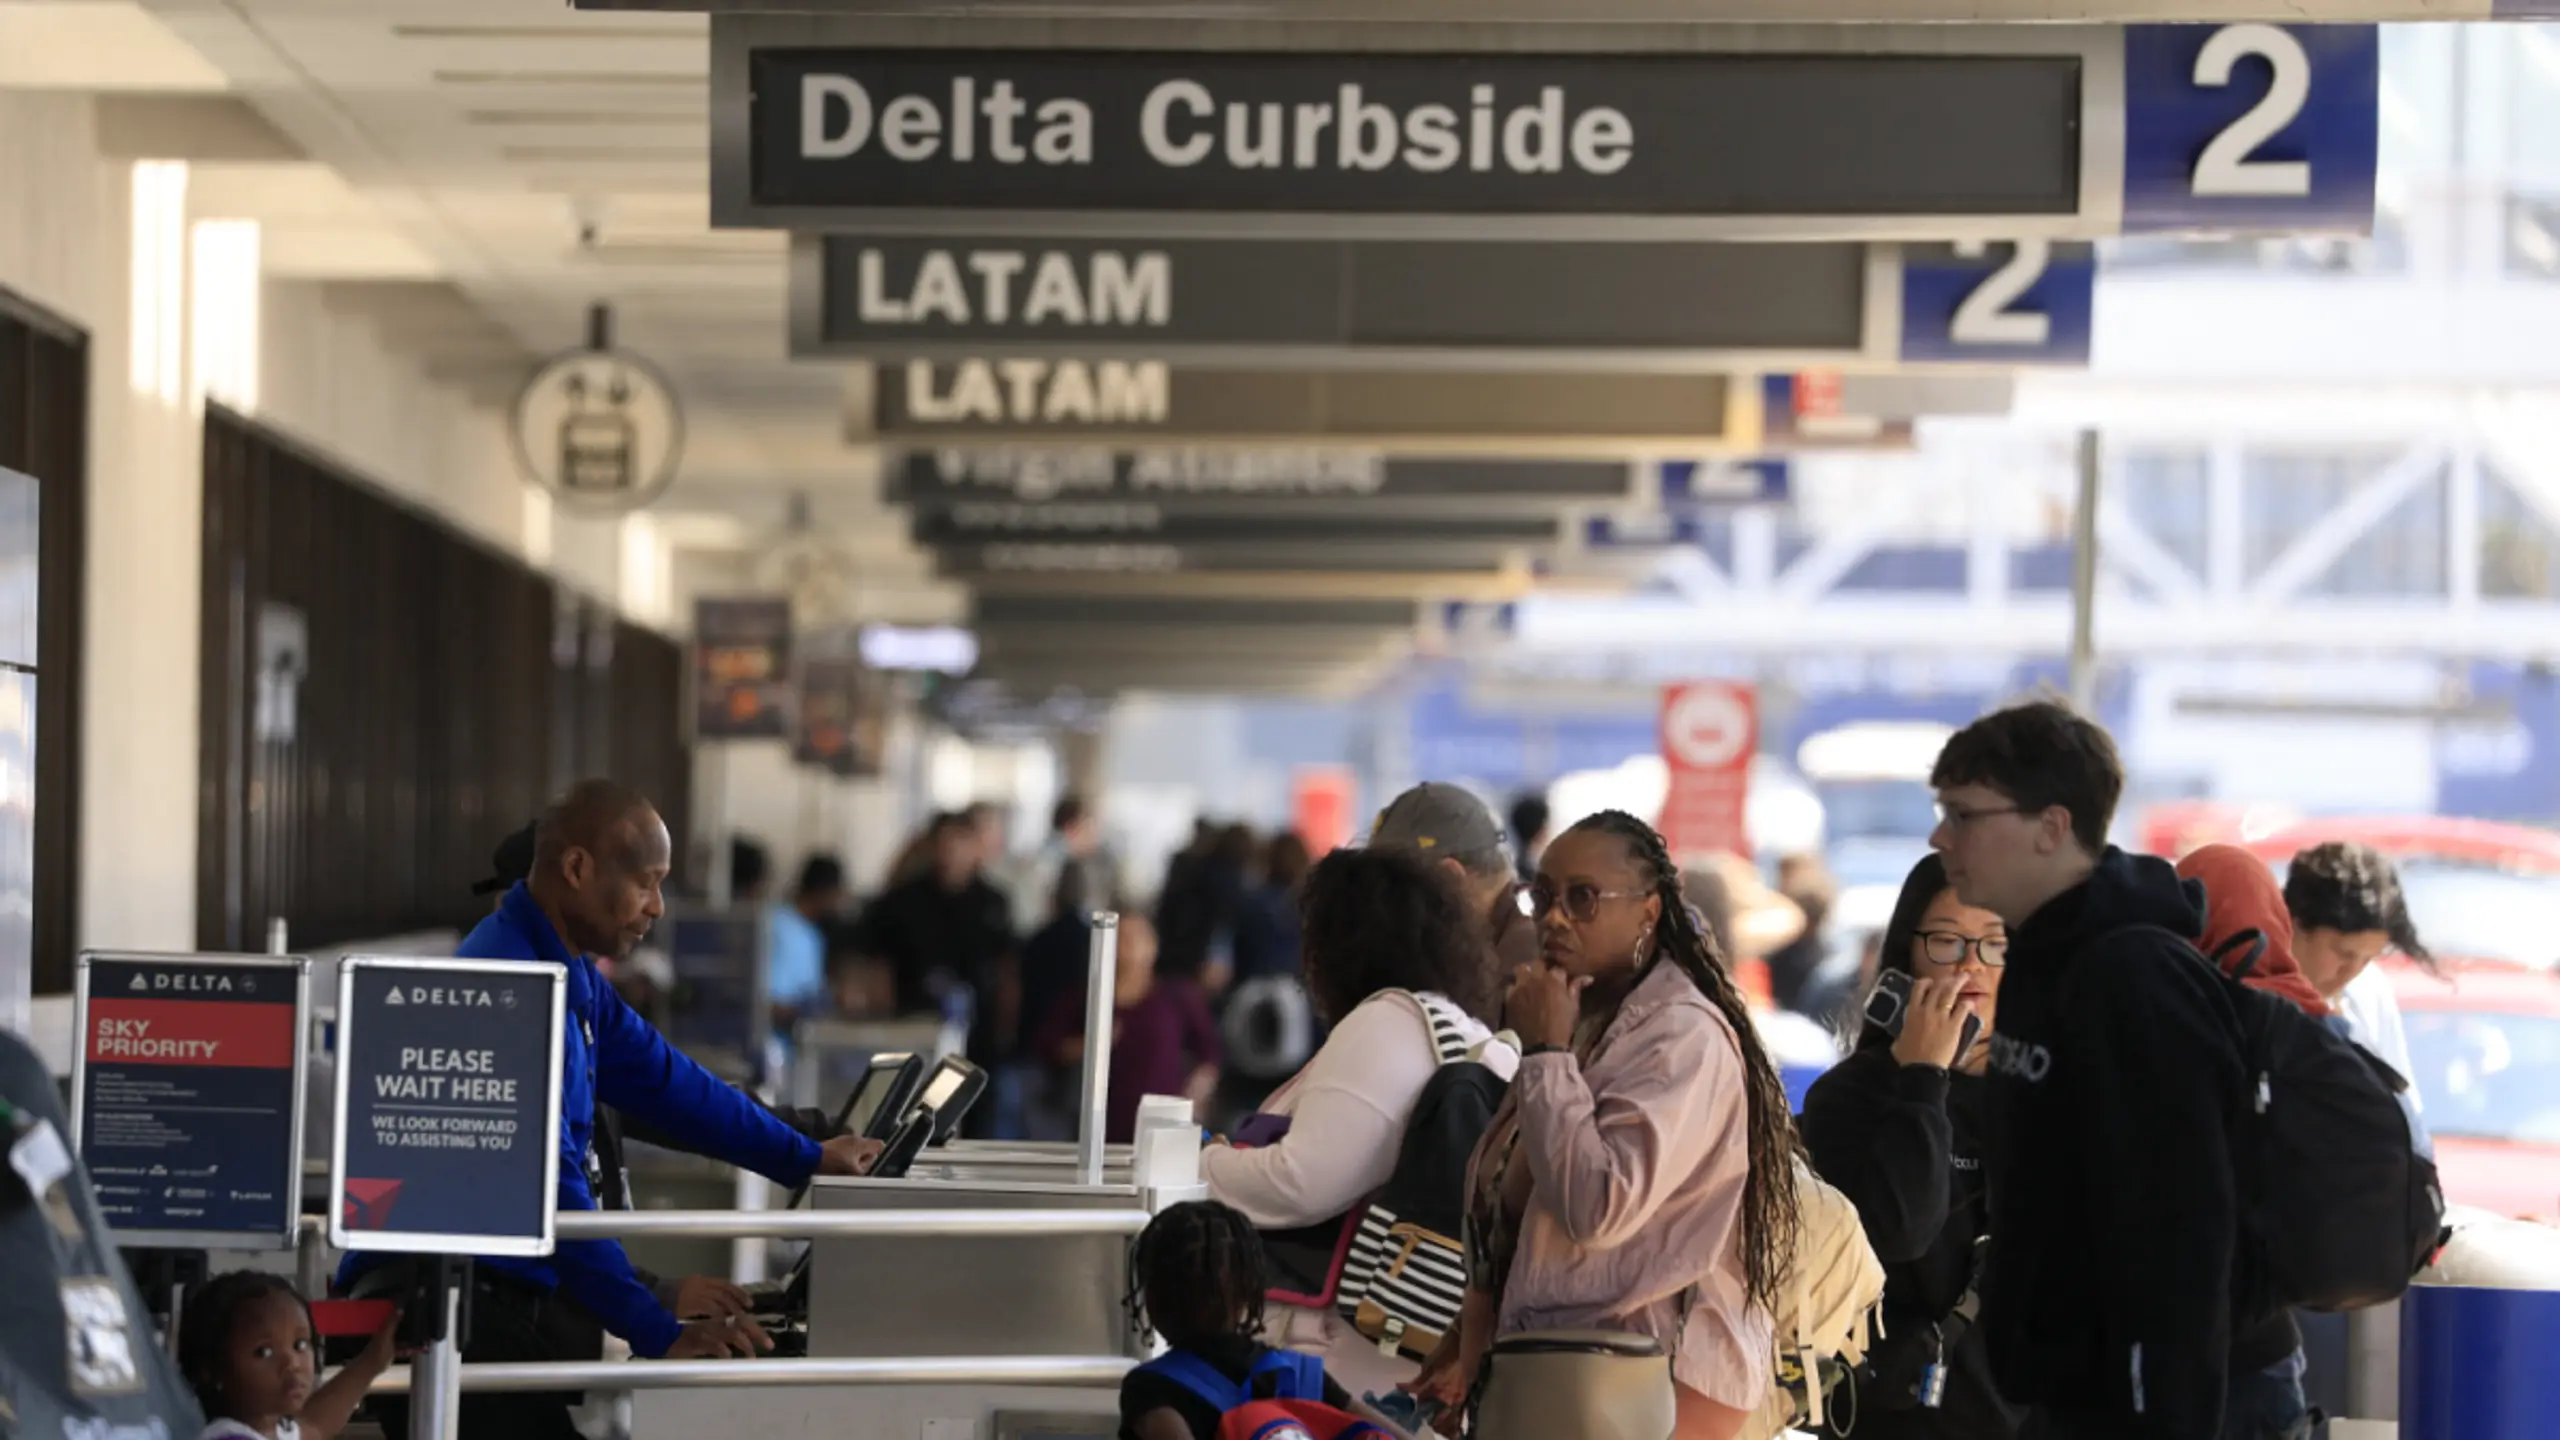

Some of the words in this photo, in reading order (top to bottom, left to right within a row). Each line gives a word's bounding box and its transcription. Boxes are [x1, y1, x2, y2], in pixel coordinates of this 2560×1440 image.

[2191, 25, 2311, 196] 2
[800, 74, 1092, 164] Delta
[1139, 80, 1634, 174] Curbside
[858, 251, 1171, 326] LATAM
[1950, 241, 2051, 346] 2
[906, 362, 1168, 422] LATAM
[154, 974, 232, 992] DELTA
[411, 987, 492, 1007] DELTA
[98, 1019, 150, 1038] SKY
[97, 1038, 217, 1059] PRIORITY
[401, 1047, 494, 1073] PLEASE
[375, 1074, 445, 1099] WAIT
[451, 1077, 517, 1102] HERE
[372, 1115, 396, 1129] WE
[399, 1116, 439, 1130] LOOK
[442, 1118, 517, 1134] FORWARD
[376, 1131, 397, 1146] TO
[400, 1132, 476, 1148] ASSISTING
[479, 1135, 512, 1150] YOU
